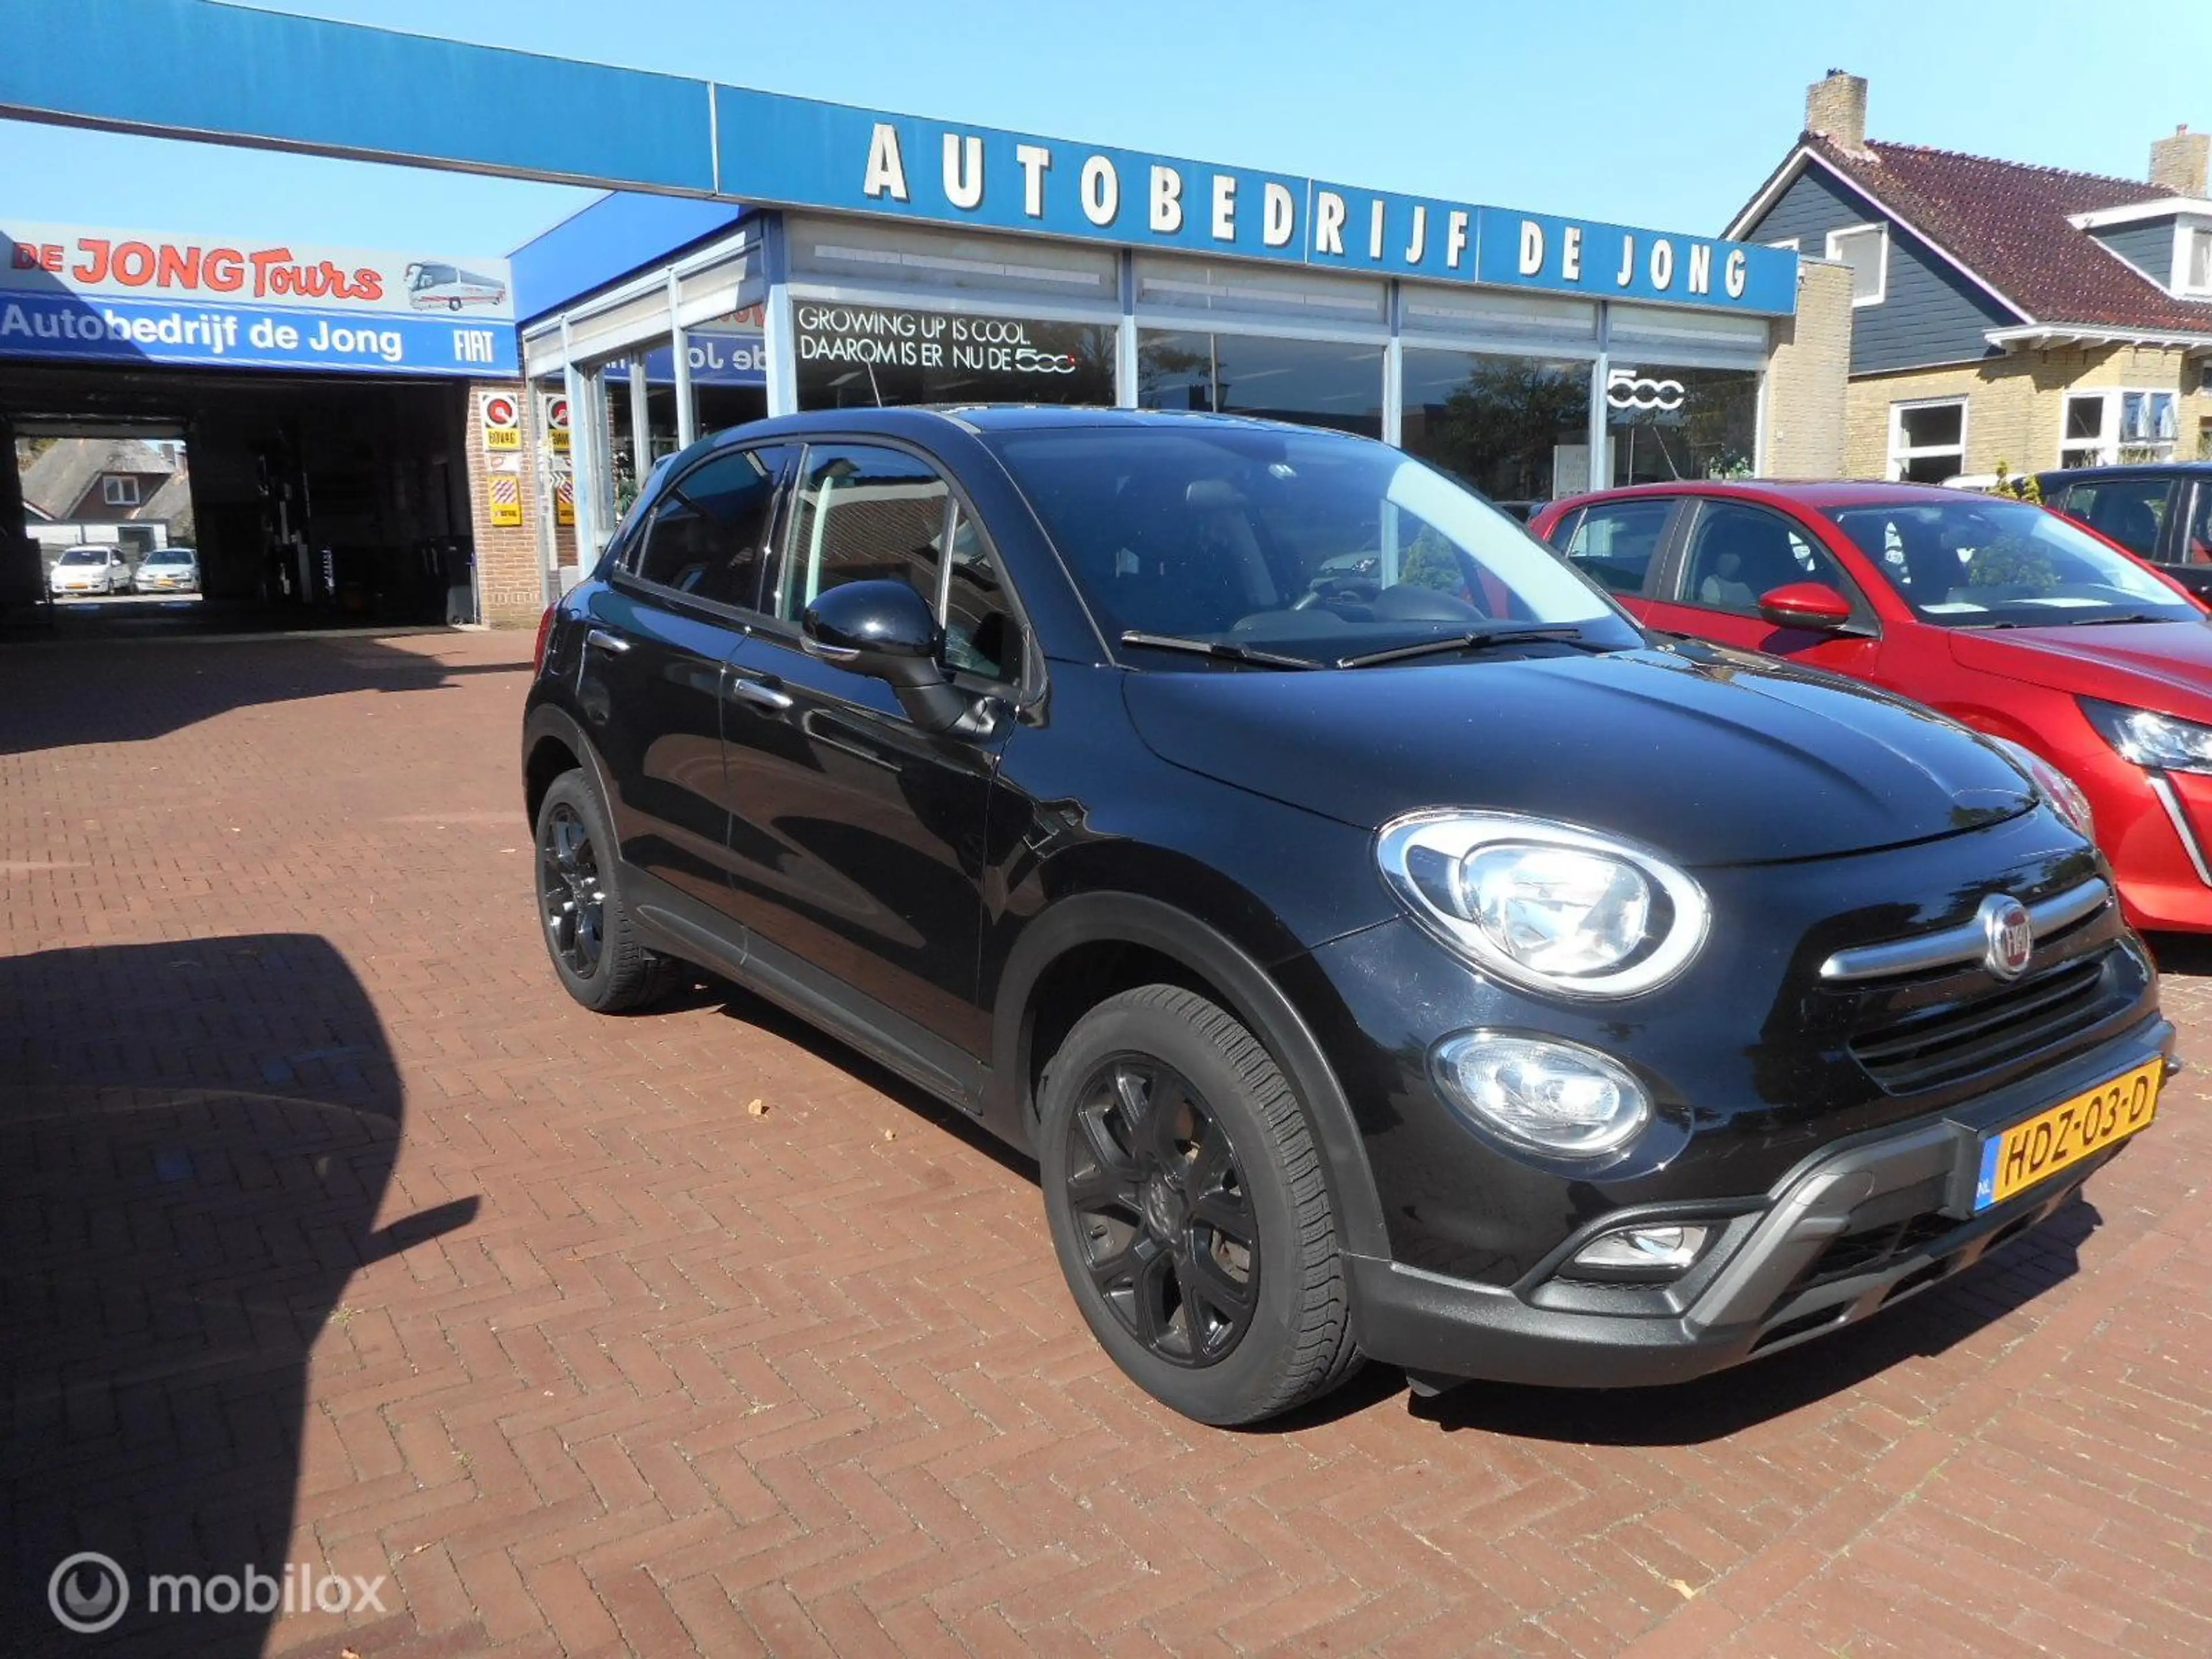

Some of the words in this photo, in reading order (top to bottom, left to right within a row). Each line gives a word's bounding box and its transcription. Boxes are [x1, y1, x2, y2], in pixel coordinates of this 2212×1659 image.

[863, 122, 1469, 268] AUTOBEDRIJF
[1518, 219, 1583, 281] DE
[1616, 234, 1748, 299] JONG
[11, 241, 65, 273] DE
[73, 237, 246, 293] JONG
[249, 247, 384, 301] Tours
[2, 302, 237, 354] Autobedrijf
[249, 317, 298, 349] de
[309, 321, 402, 361] Jong
[453, 328, 495, 364] FIAT
[798, 306, 916, 337] GROWING
[922, 318, 946, 340] UP
[953, 317, 968, 341] IS
[800, 335, 897, 365] DAAROM
[902, 342, 916, 366] IS
[921, 343, 944, 368] ER
[953, 346, 983, 370] NU
[989, 347, 1012, 371] DE
[1607, 368, 1685, 410] 500
[2003, 1074, 2149, 1187] HDZ-03-D
